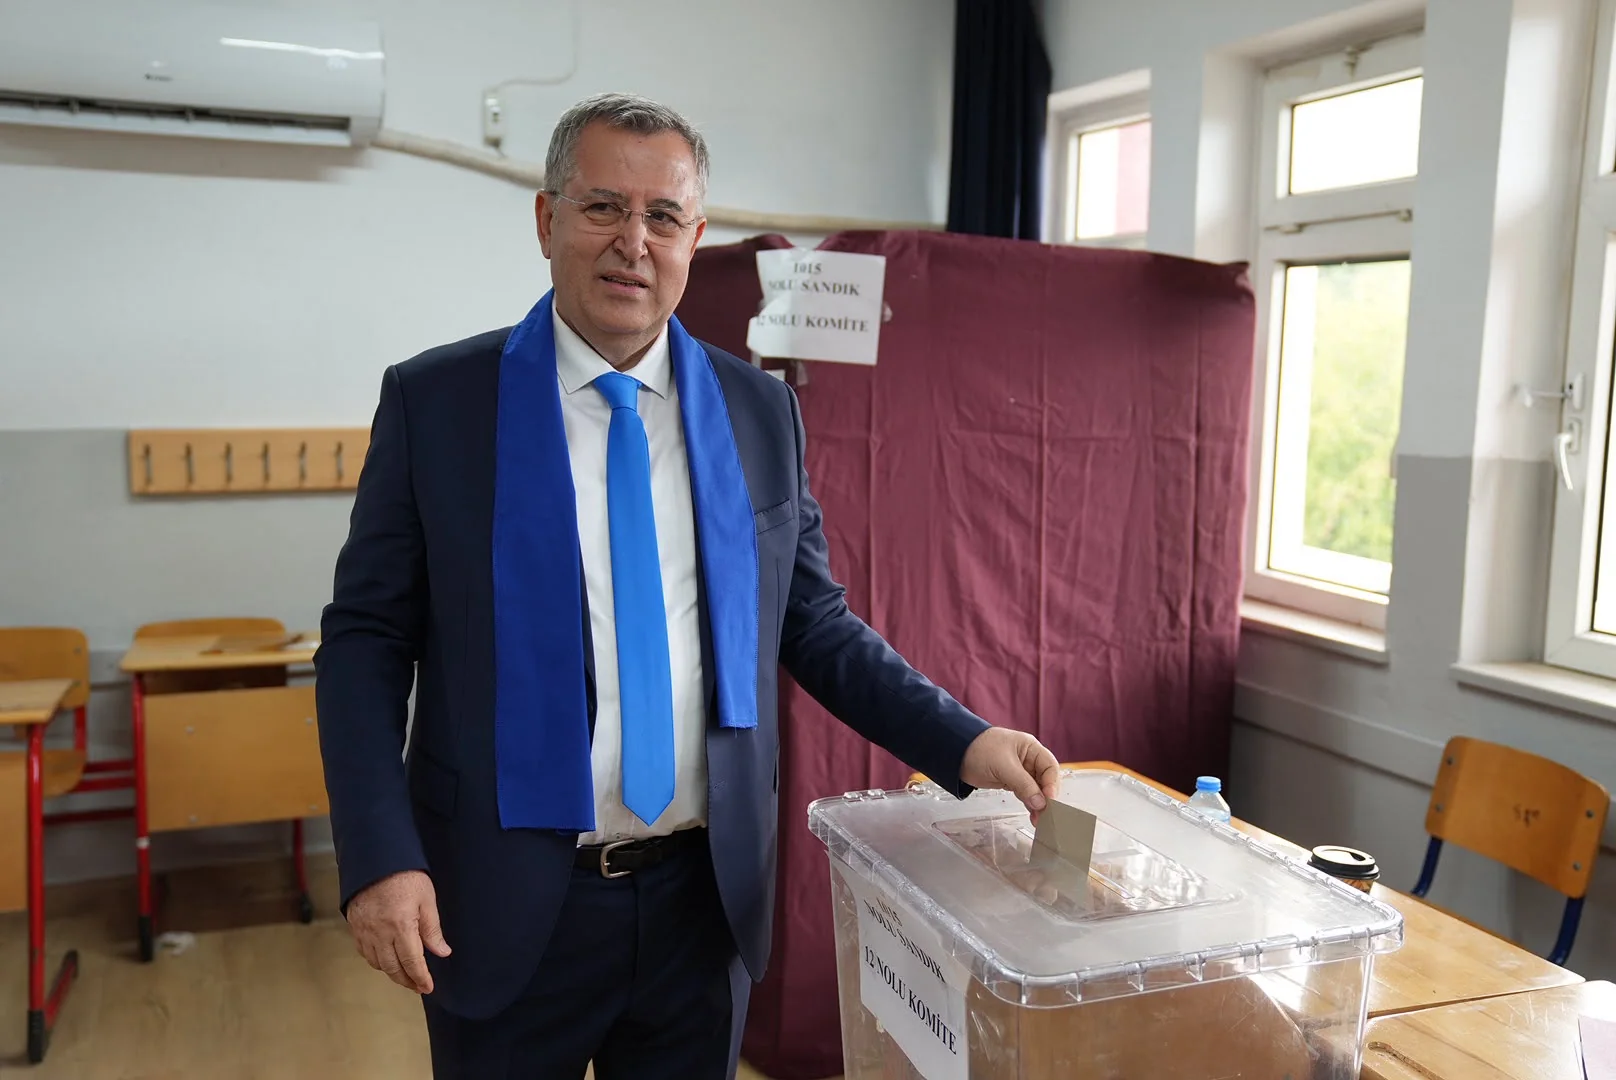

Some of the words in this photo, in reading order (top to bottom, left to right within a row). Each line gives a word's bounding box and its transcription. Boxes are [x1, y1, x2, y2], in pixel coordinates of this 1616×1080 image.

[793, 262, 823, 275] 1015
[801, 281, 860, 296] SANDIK
[806, 314, 869, 332] KOMİTE
[863, 899, 897, 938] NOLU
[898, 928, 946, 984] SANDIK
[865, 945, 875, 969] 12
[877, 957, 906, 1000] NOLU
[908, 988, 957, 1055] KOMİTE
